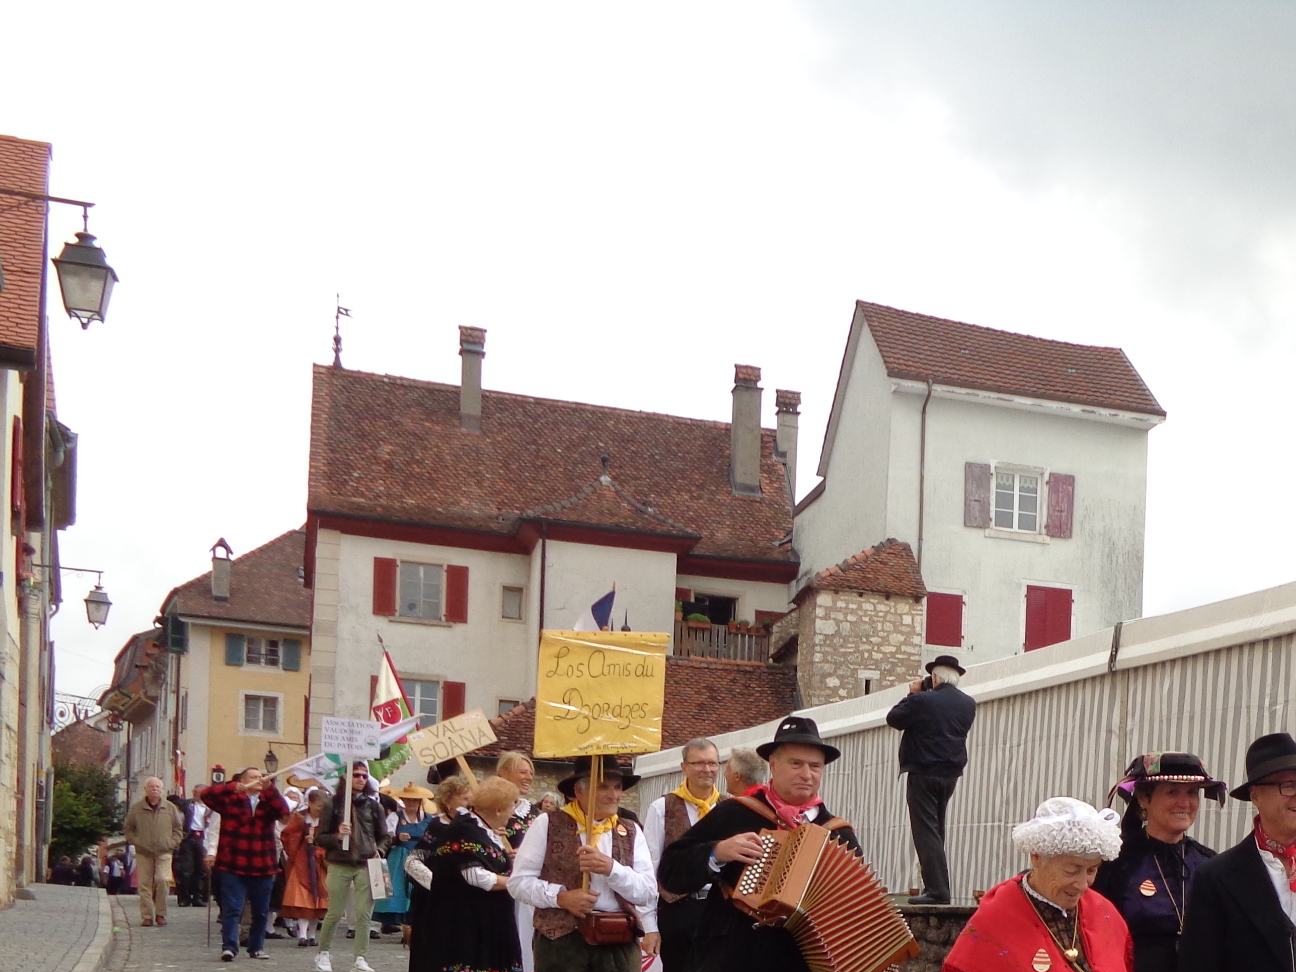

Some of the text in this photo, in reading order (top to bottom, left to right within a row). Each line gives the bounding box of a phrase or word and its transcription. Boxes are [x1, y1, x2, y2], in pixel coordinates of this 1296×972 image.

[587, 649, 631, 679] Amis
[634, 656, 656, 679] du
[325, 719, 375, 730] ASSOCIATION
[324, 726, 363, 735] VAUDOISE
[427, 721, 465, 739] VAL
[324, 733, 359, 743] DES AMIS
[337, 742, 364, 750] PATOIS
